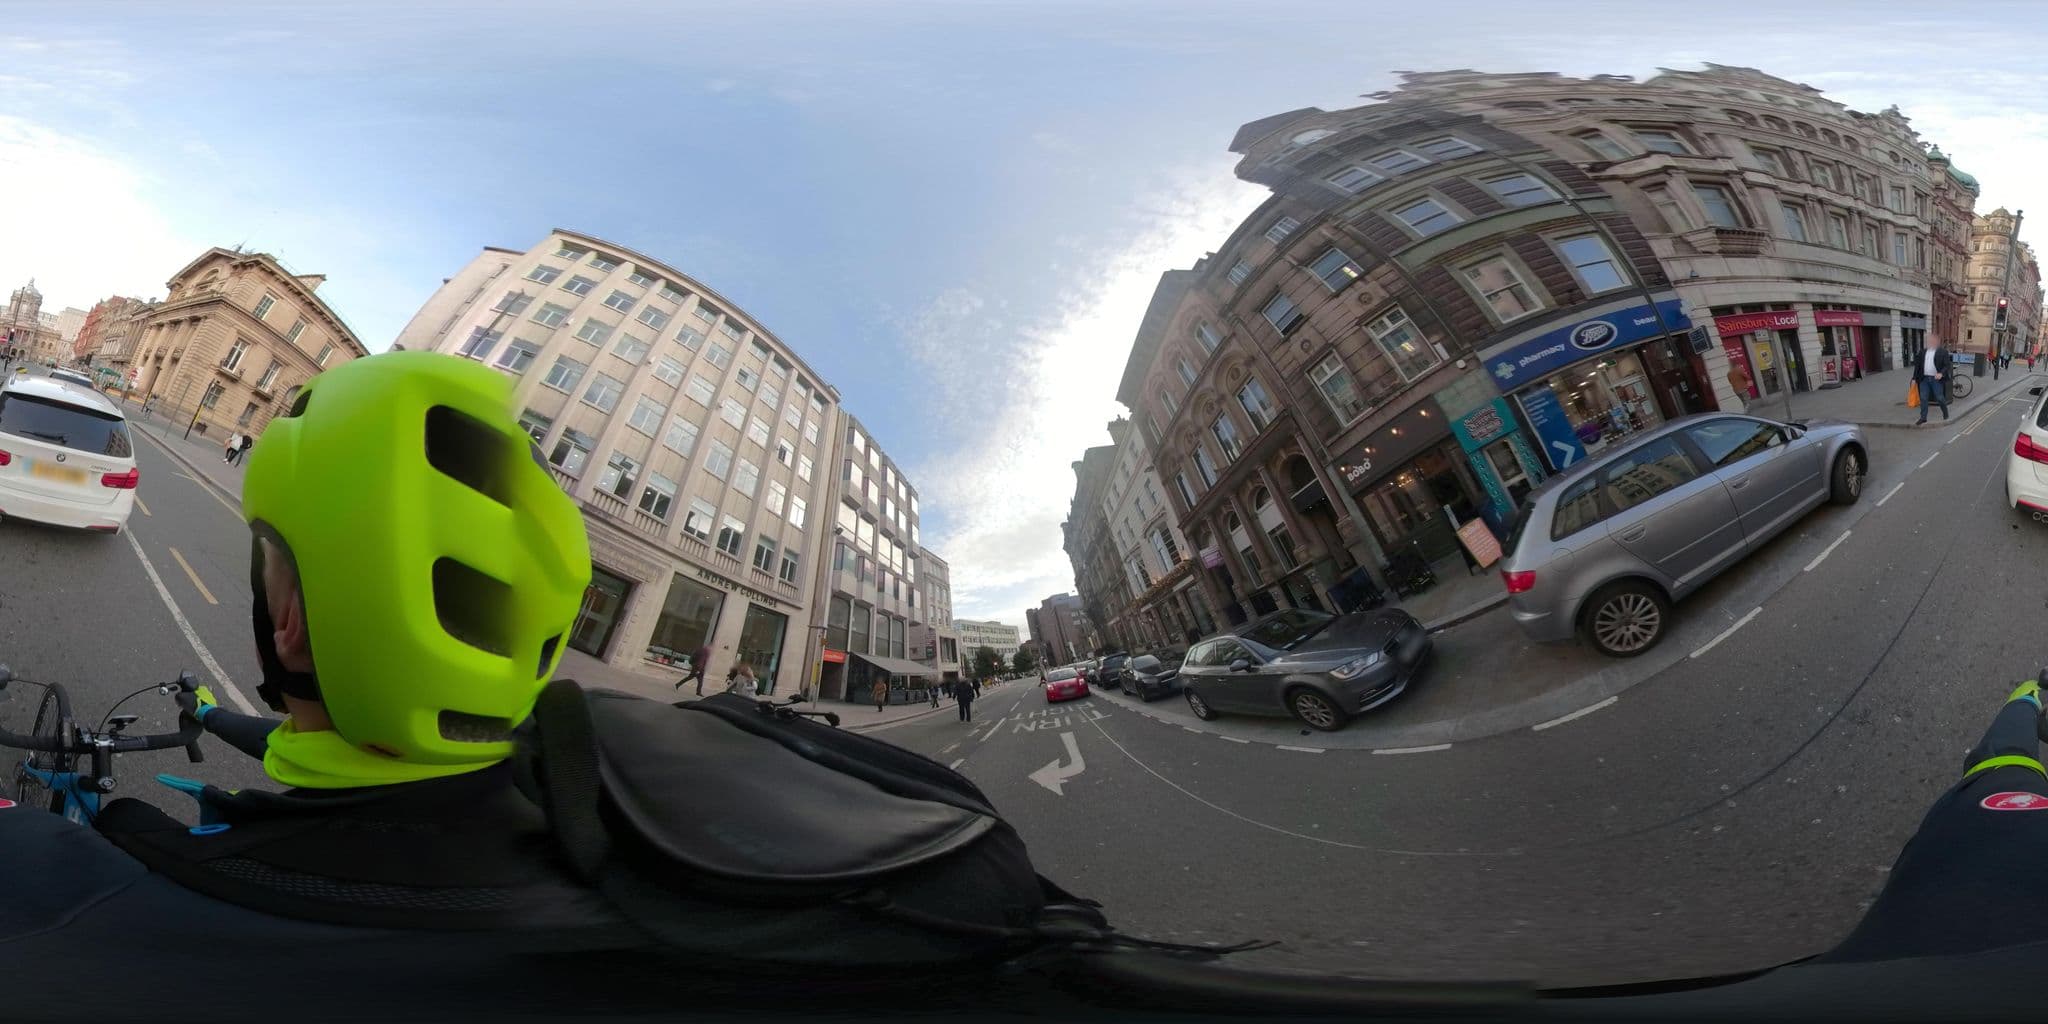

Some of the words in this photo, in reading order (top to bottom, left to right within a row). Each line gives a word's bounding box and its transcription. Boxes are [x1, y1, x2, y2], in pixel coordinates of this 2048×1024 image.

[1633, 315, 1656, 326] beau
[1718, 317, 1774, 333] Sainsbury's
[1775, 315, 1798, 326] Local
[1580, 324, 1609, 345] Boots
[1518, 344, 1565, 368] pharmacy
[697, 570, 738, 592] ANDREW
[740, 587, 777, 607] COLLINGE
[1012, 711, 1113, 734] TURN
